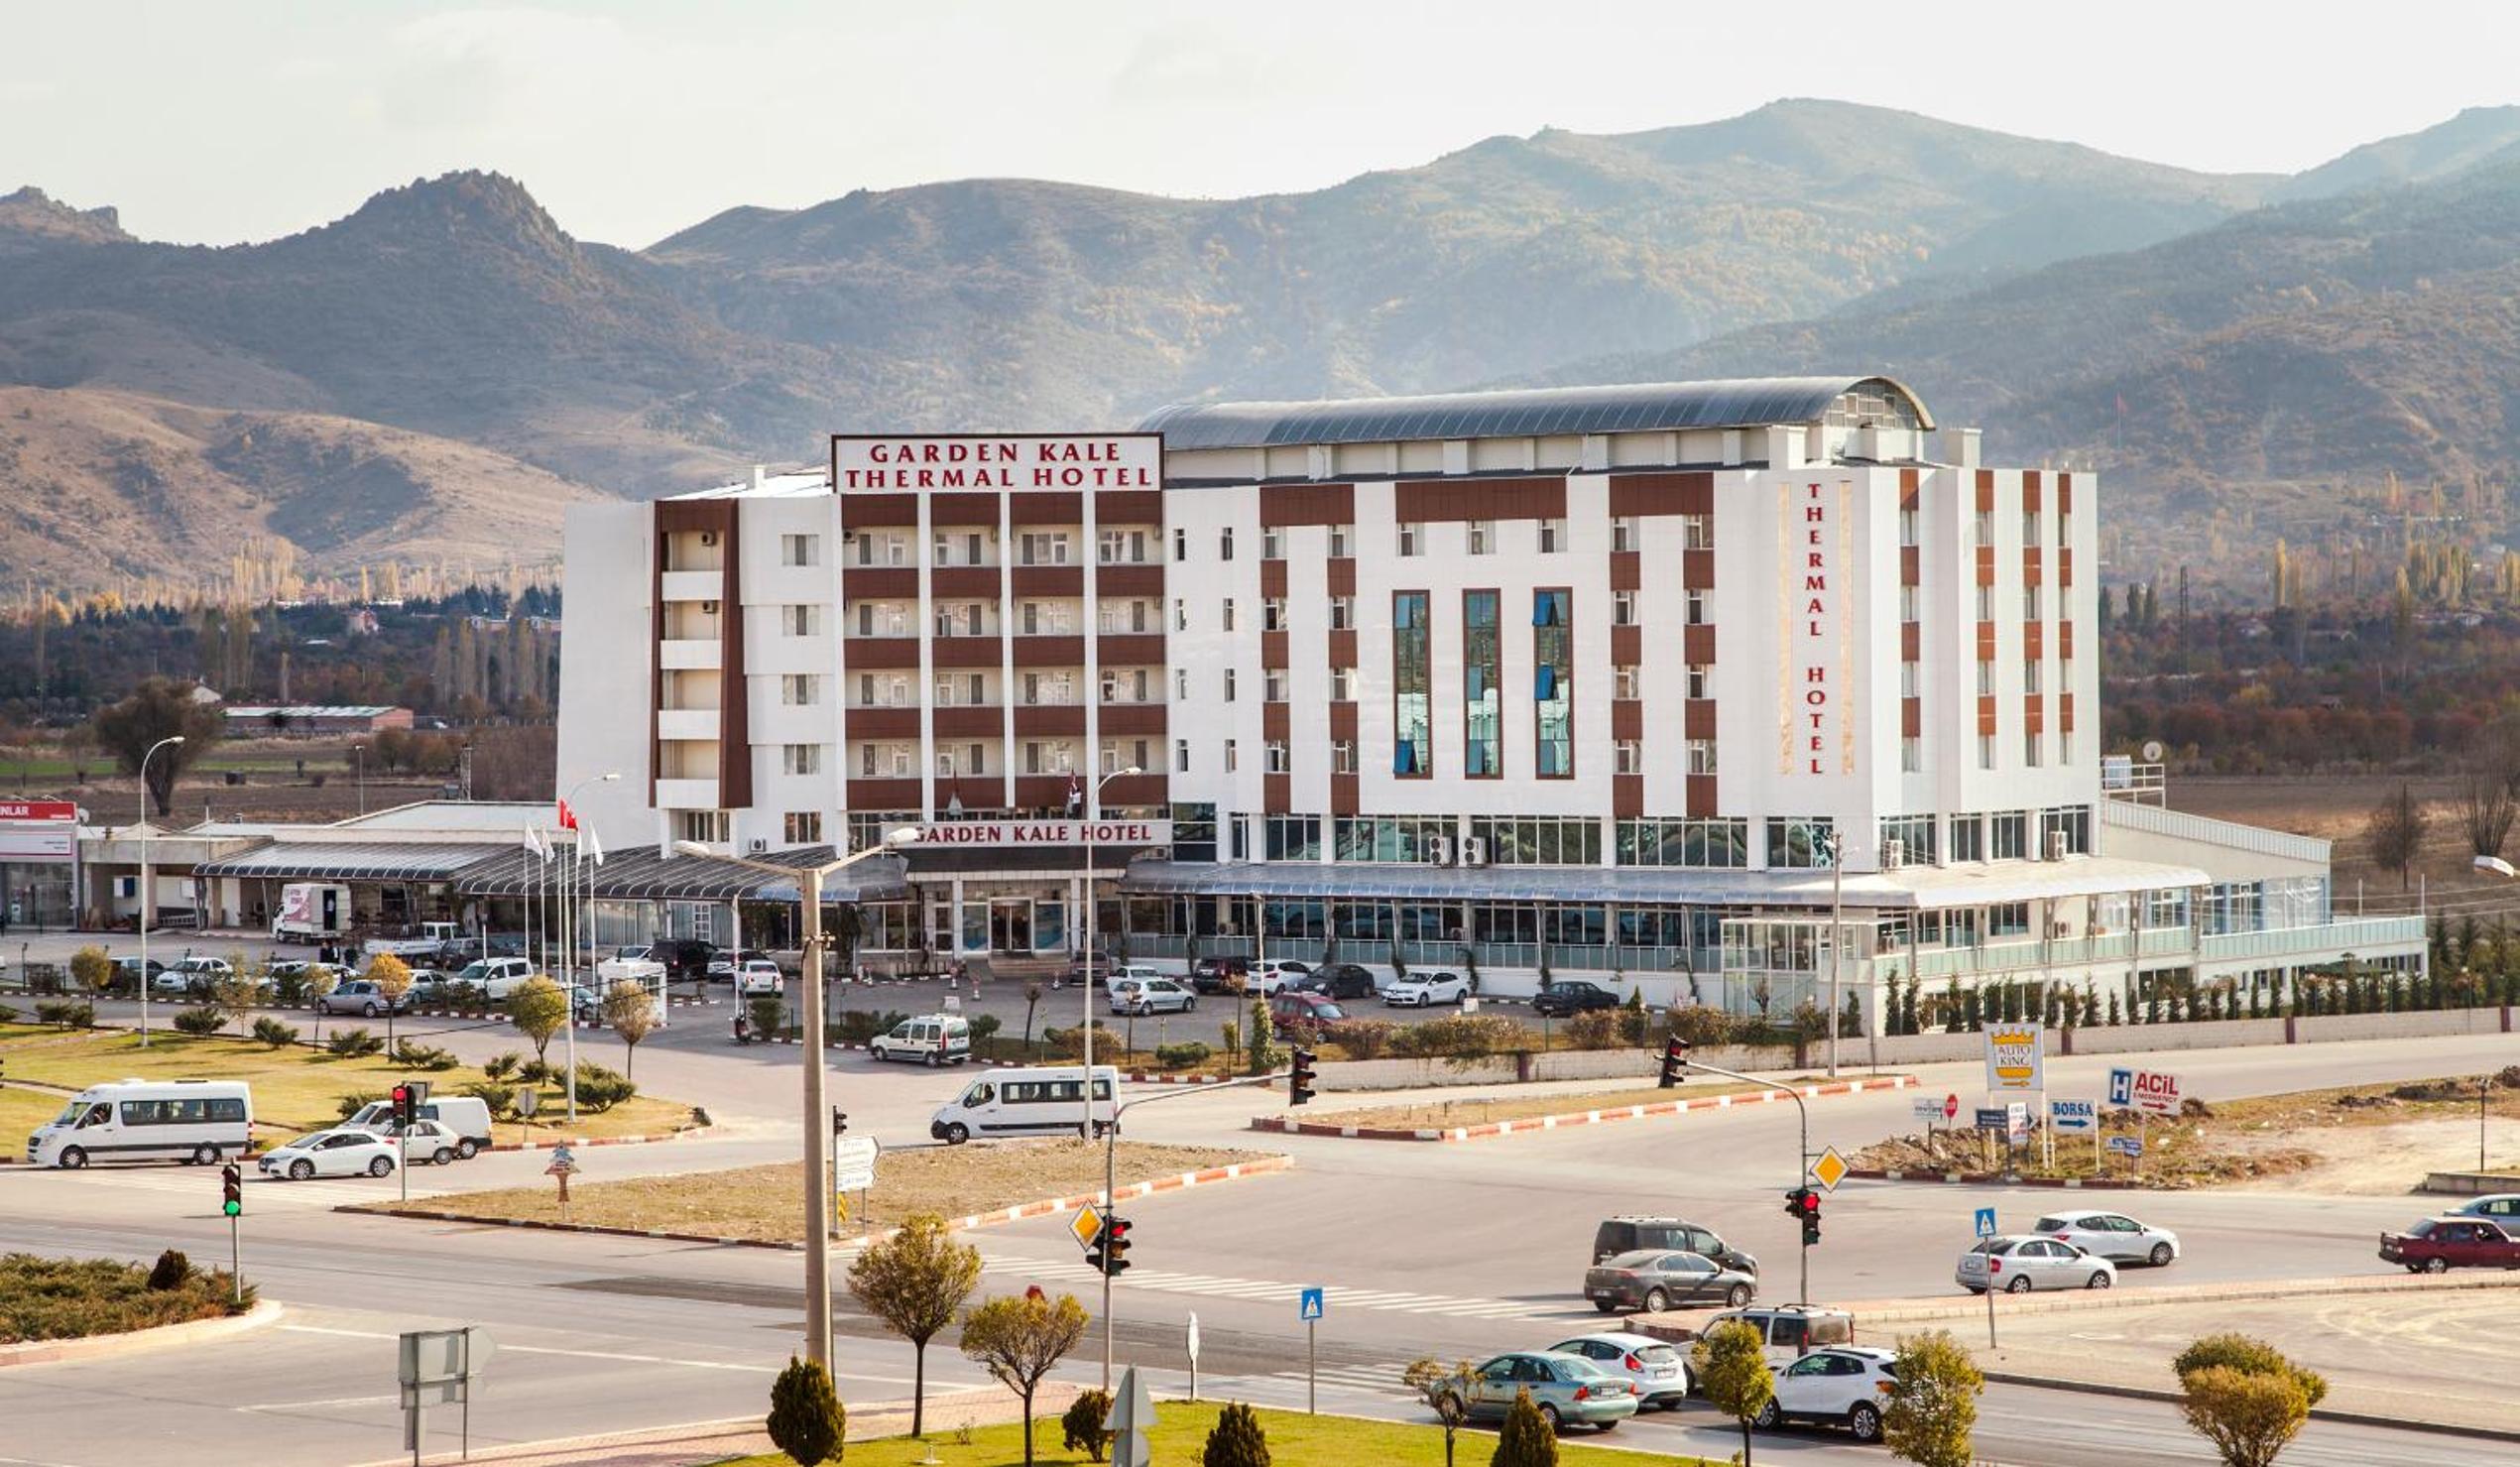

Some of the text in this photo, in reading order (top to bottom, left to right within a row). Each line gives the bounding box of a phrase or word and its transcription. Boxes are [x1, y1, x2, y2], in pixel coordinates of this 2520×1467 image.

[870, 442, 1121, 462] GARDEN KALE
[845, 467, 1150, 488] THERMAL HOTEL
[1805, 483, 1826, 775] THERMAL HOTEL
[0, 805, 29, 816] NLAR
[914, 825, 1151, 843] GARDEN KALE HOTEL
[2052, 1102, 2094, 1117] BORSA
